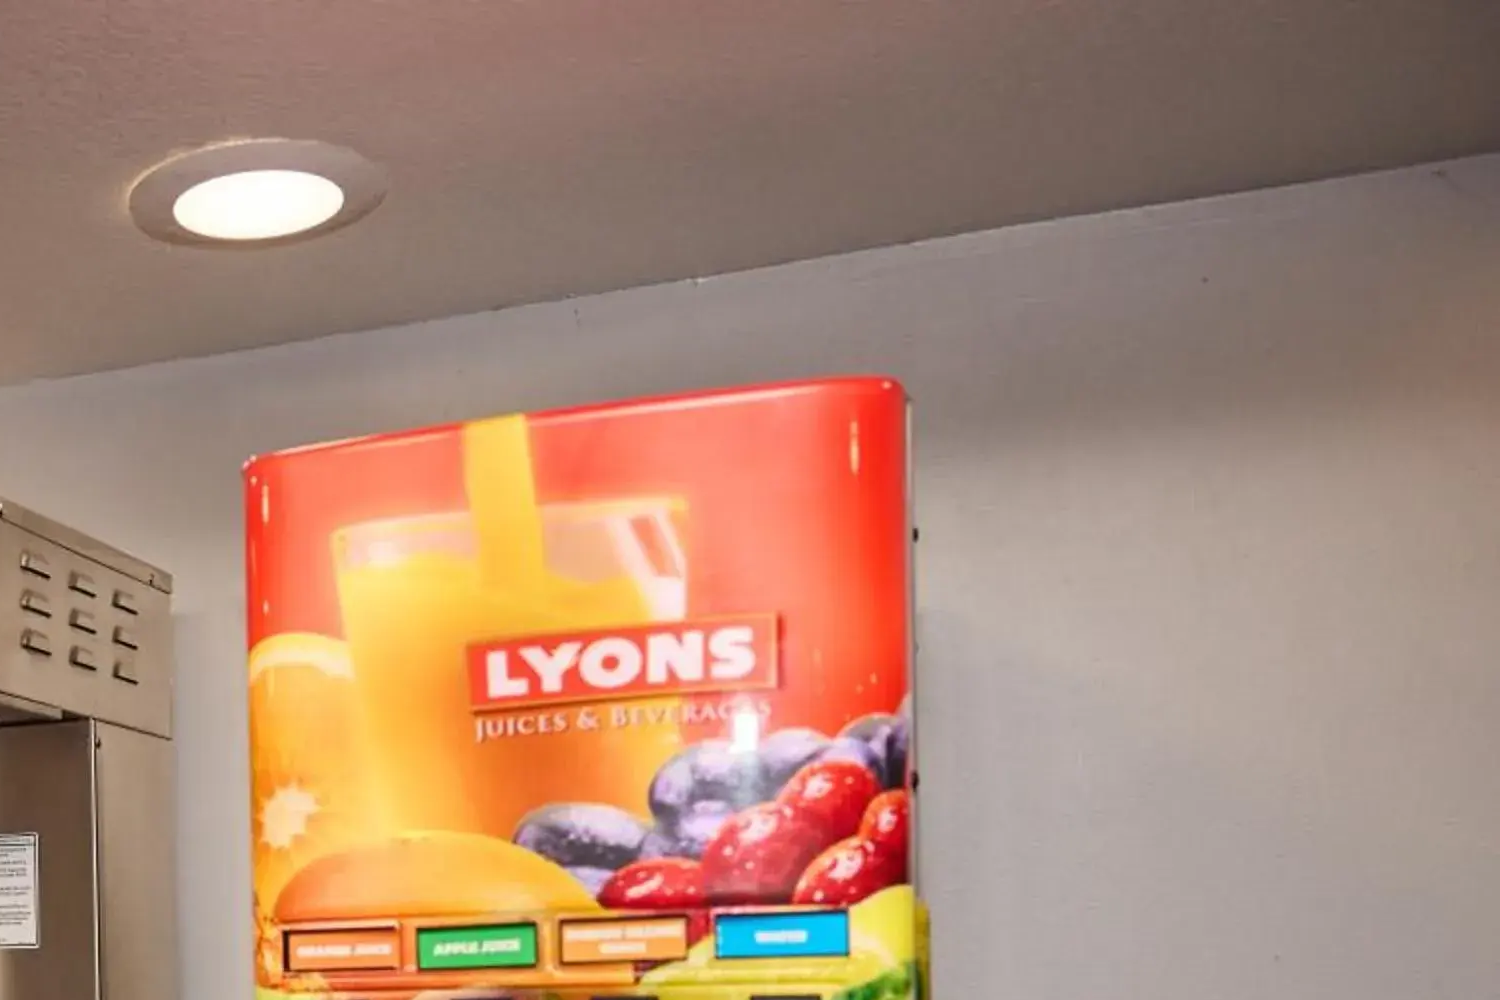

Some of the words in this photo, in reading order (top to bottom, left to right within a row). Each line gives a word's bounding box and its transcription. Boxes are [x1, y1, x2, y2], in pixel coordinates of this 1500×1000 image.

[486, 627, 756, 699] LYONS
[475, 711, 567, 743] JUICES
[576, 707, 599, 731] &
